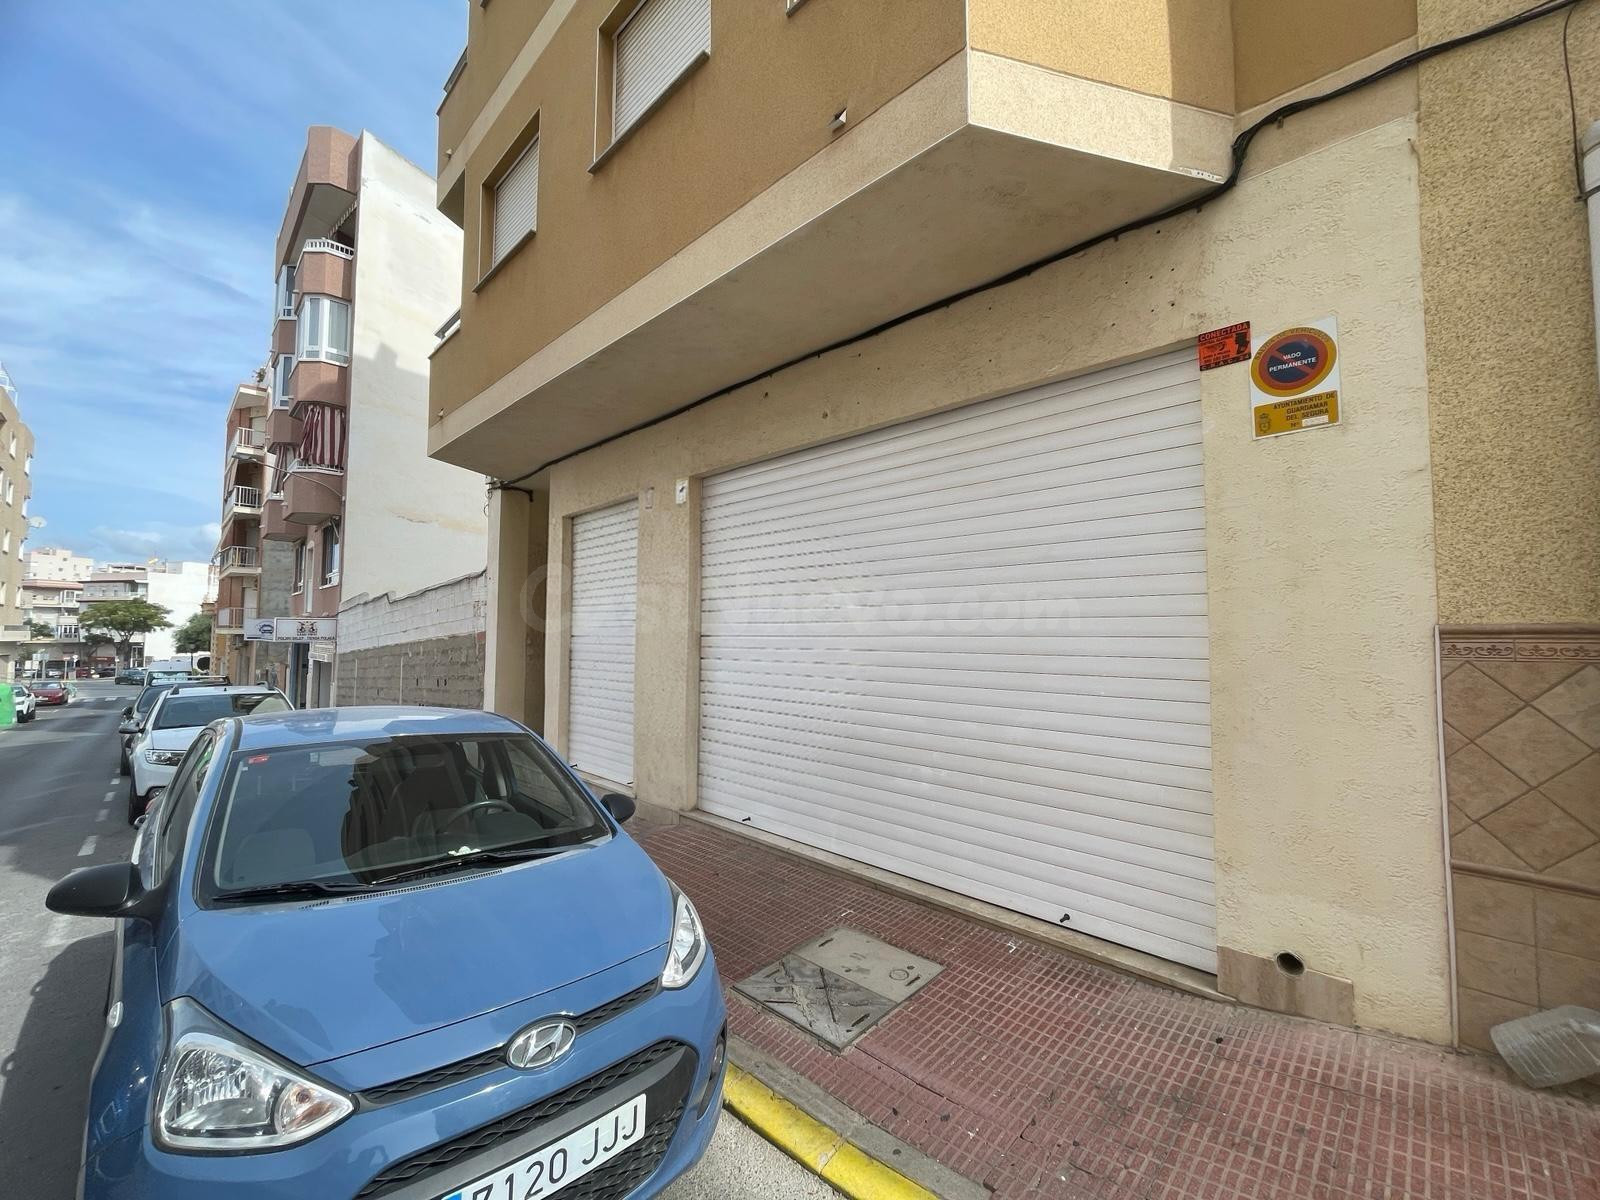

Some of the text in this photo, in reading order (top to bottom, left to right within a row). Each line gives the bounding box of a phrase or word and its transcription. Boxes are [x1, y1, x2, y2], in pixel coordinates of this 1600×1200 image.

[1200, 322, 1248, 341] CONECTADA
[1283, 351, 1302, 360] VADO
[1269, 356, 1317, 373] PERMANENTE
[1273, 392, 1336, 409] AYUNTAMIENTO DE
[1286, 401, 1328, 415] GUARDAMAR
[1286, 409, 1329, 421] DEL SEGURA
[582, 1104, 638, 1166] JJJ
